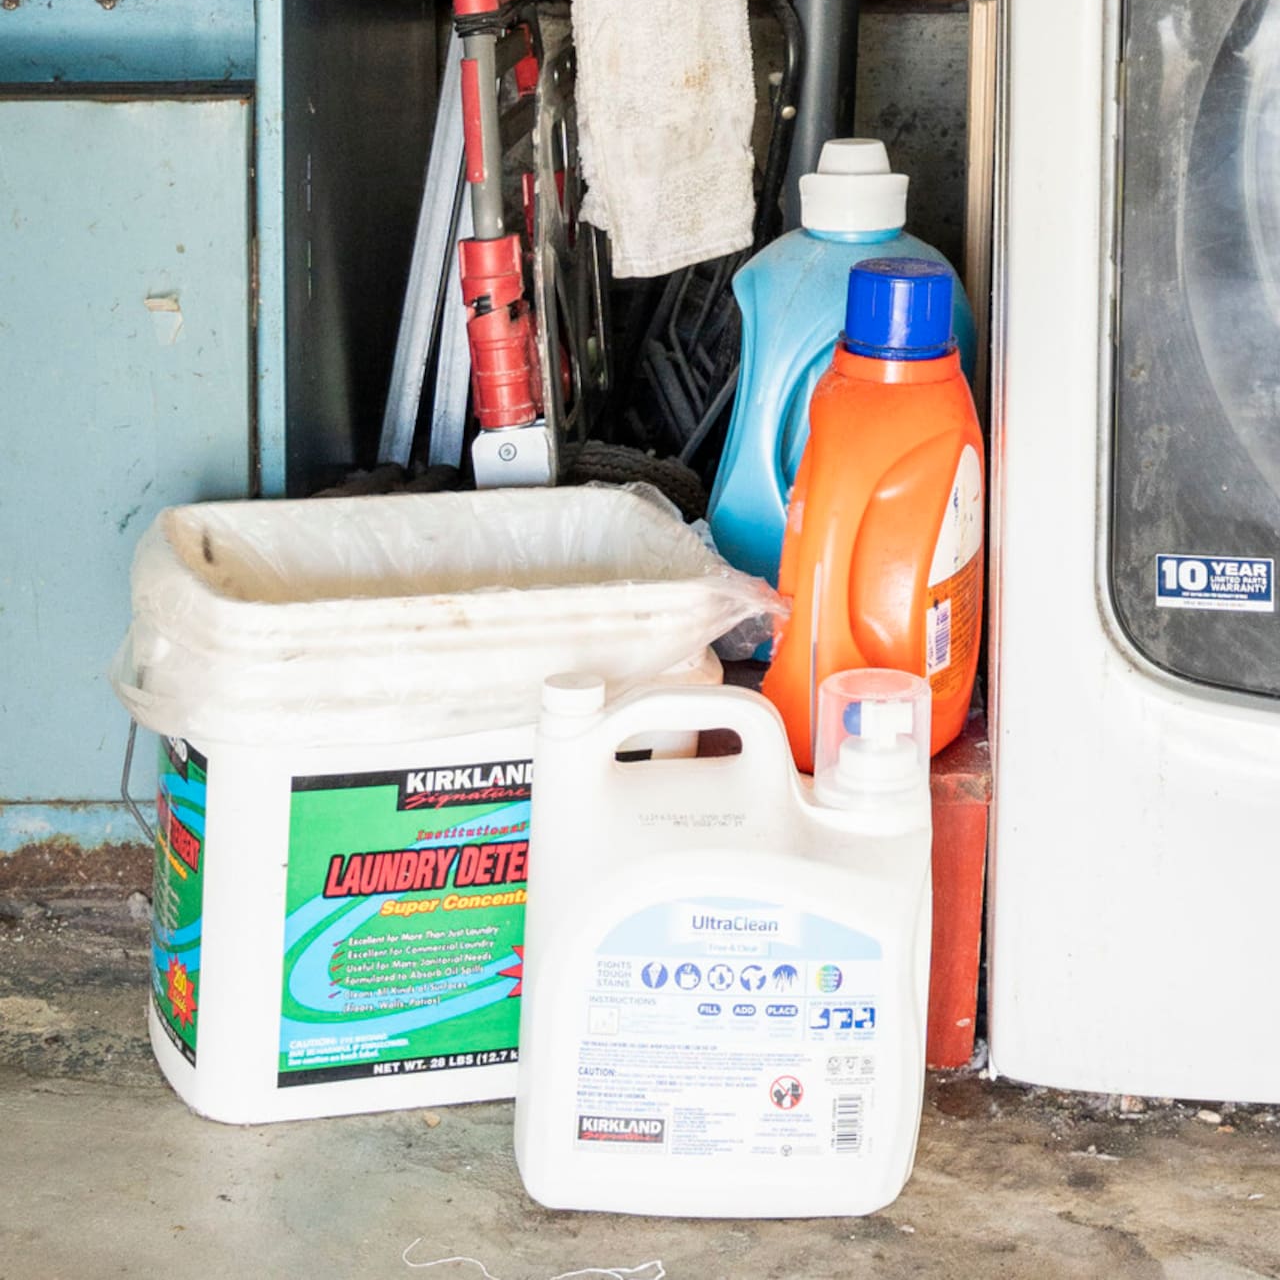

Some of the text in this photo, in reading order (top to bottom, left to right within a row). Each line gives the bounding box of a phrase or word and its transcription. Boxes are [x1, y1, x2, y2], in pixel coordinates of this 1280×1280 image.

[1162, 559, 1267, 591] 10 YEAR
[1211, 582, 1267, 593] WARRANTY
[405, 788, 531, 810] Signature
[416, 822, 527, 841] Institutional
[323, 846, 459, 898] LAUNDRY
[380, 899, 440, 917] Super
[692, 915, 779, 932] UltraClean
[349, 926, 498, 946] Excellent for More Than Just Laundry
[348, 940, 494, 960] Excellent for Commercial Laundry
[346, 952, 492, 973] Useful for Many Janitorial Needs
[597, 961, 632, 969] FIGHTS
[345, 972, 395, 985] Formulated
[410, 968, 442, 979] Absorb
[445, 966, 459, 975] Oil
[461, 964, 484, 975] Spills
[598, 970, 632, 978] TOUGH
[596, 979, 631, 988] STAINS
[377, 988, 389, 996] All
[589, 995, 657, 1006] INSTRUCTIONS
[701, 1005, 719, 1014] FILL
[735, 1007, 754, 1015] ADD
[767, 1007, 796, 1015] PLACE
[373, 1063, 399, 1075] NET
[404, 1061, 427, 1072] WT.
[430, 1058, 445, 1069] 28
[449, 1054, 474, 1066] LBS
[476, 1051, 508, 1066] (12.7
[578, 1067, 617, 1077] CAUTION:
[582, 1118, 662, 1134] KIRKLAND
